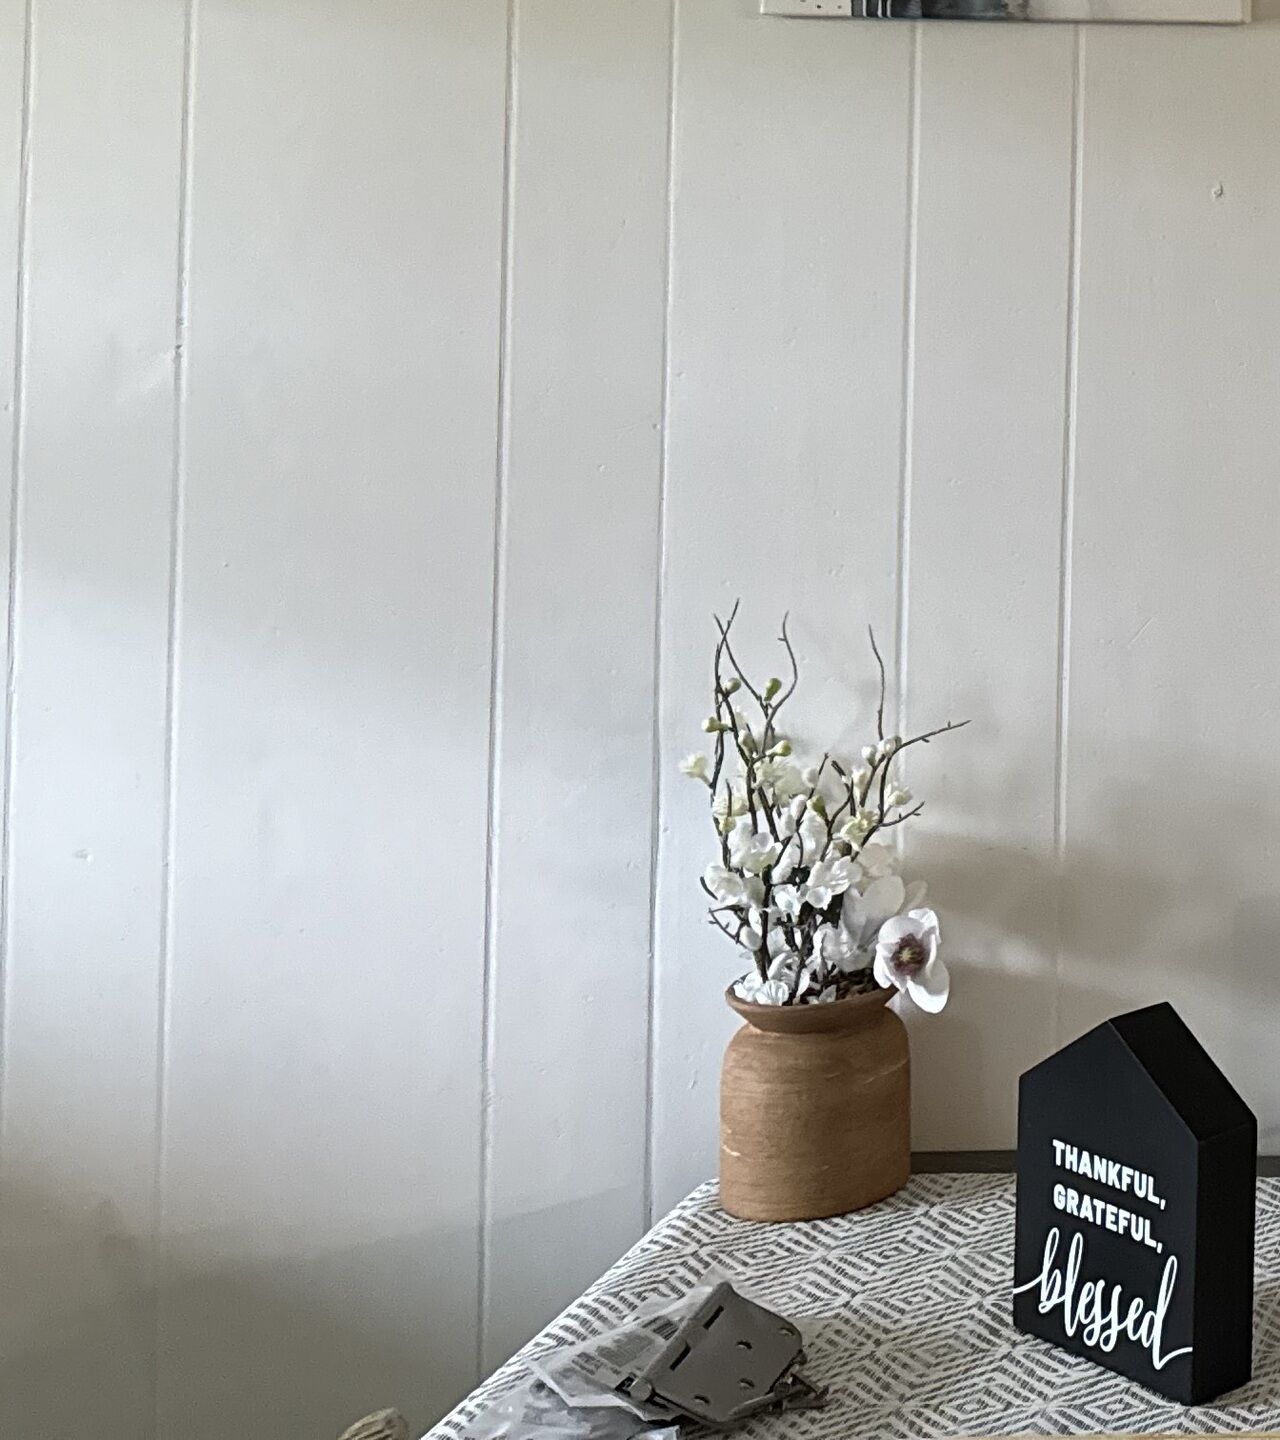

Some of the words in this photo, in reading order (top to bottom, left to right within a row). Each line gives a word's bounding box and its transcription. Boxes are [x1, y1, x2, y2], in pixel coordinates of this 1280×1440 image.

[1052, 1139, 1166, 1211] THANKFUL,
[1052, 1182, 1165, 1255] GRATEFUL,
[1015, 1226, 1192, 1371] blessed
